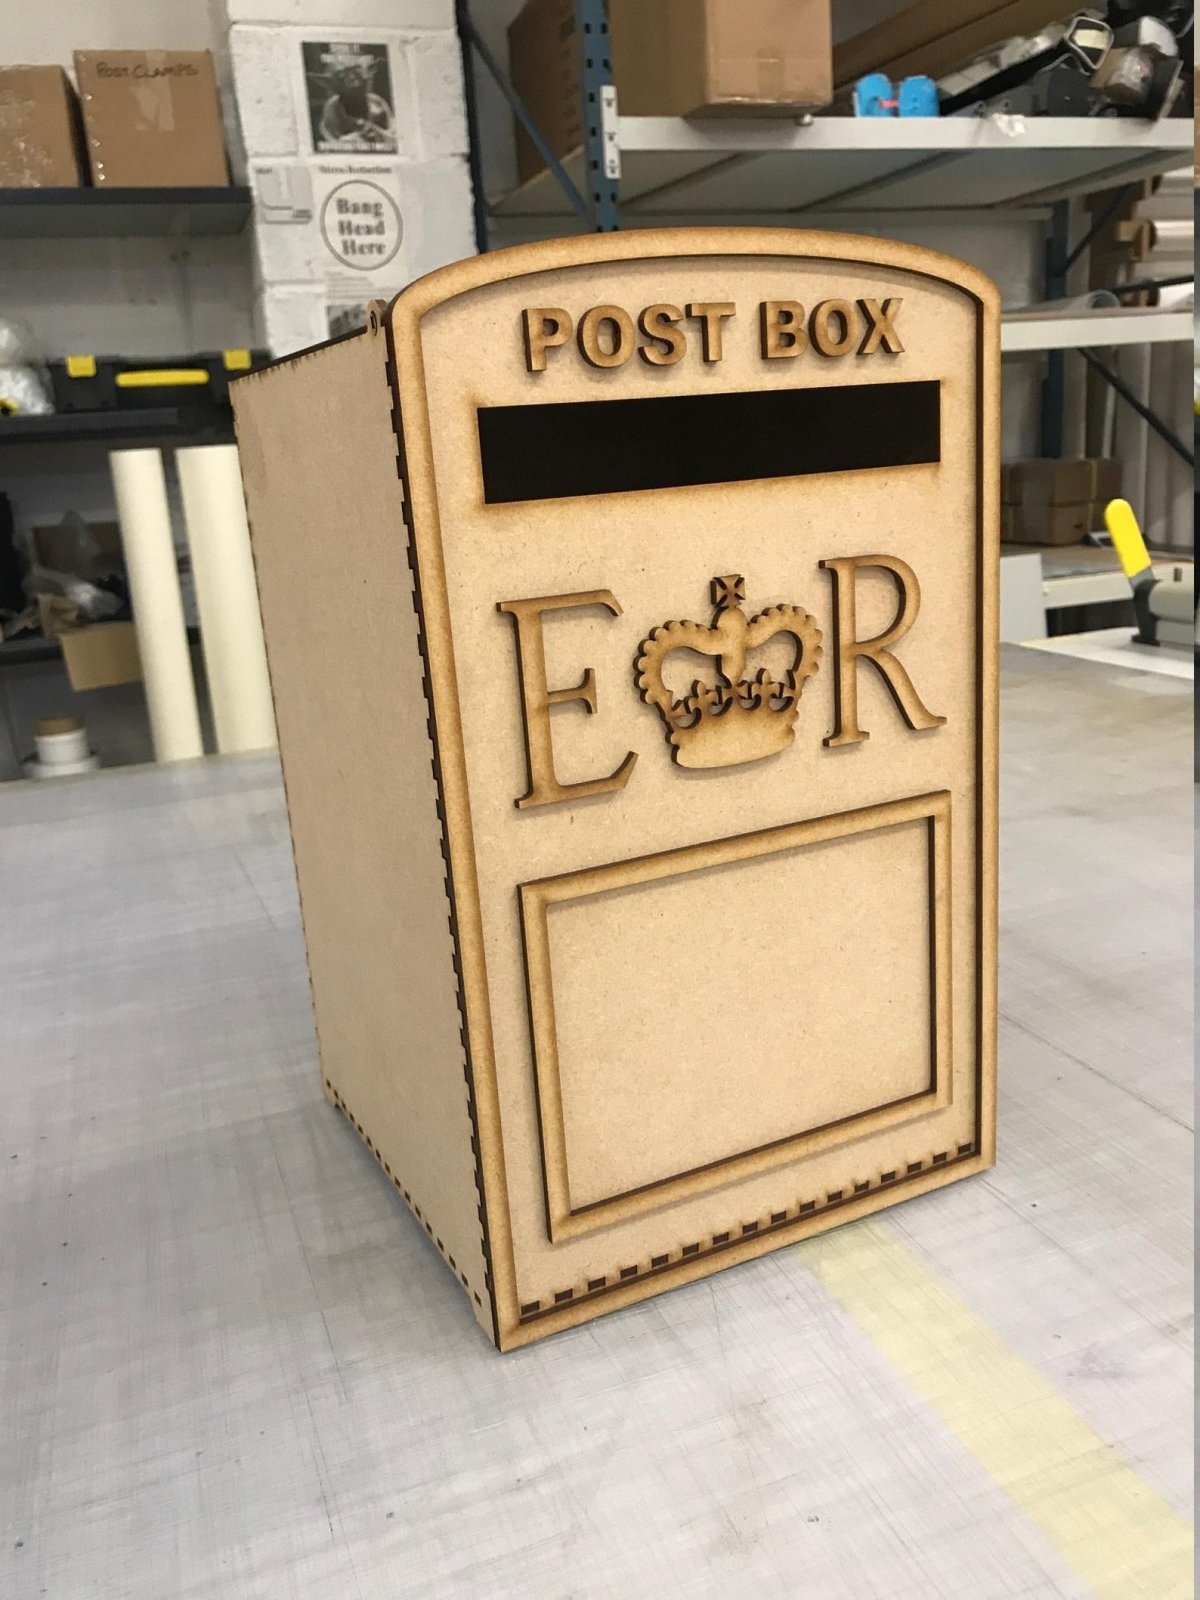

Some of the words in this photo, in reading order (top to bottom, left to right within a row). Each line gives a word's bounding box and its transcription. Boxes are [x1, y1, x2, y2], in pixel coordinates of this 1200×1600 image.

[336, 198, 384, 219] Bang
[338, 220, 386, 236] Head
[342, 239, 386, 255] Here
[521, 301, 736, 373] POST
[759, 297, 906, 361] BOX
[496, 589, 639, 809] E
[818, 553, 948, 748] R
